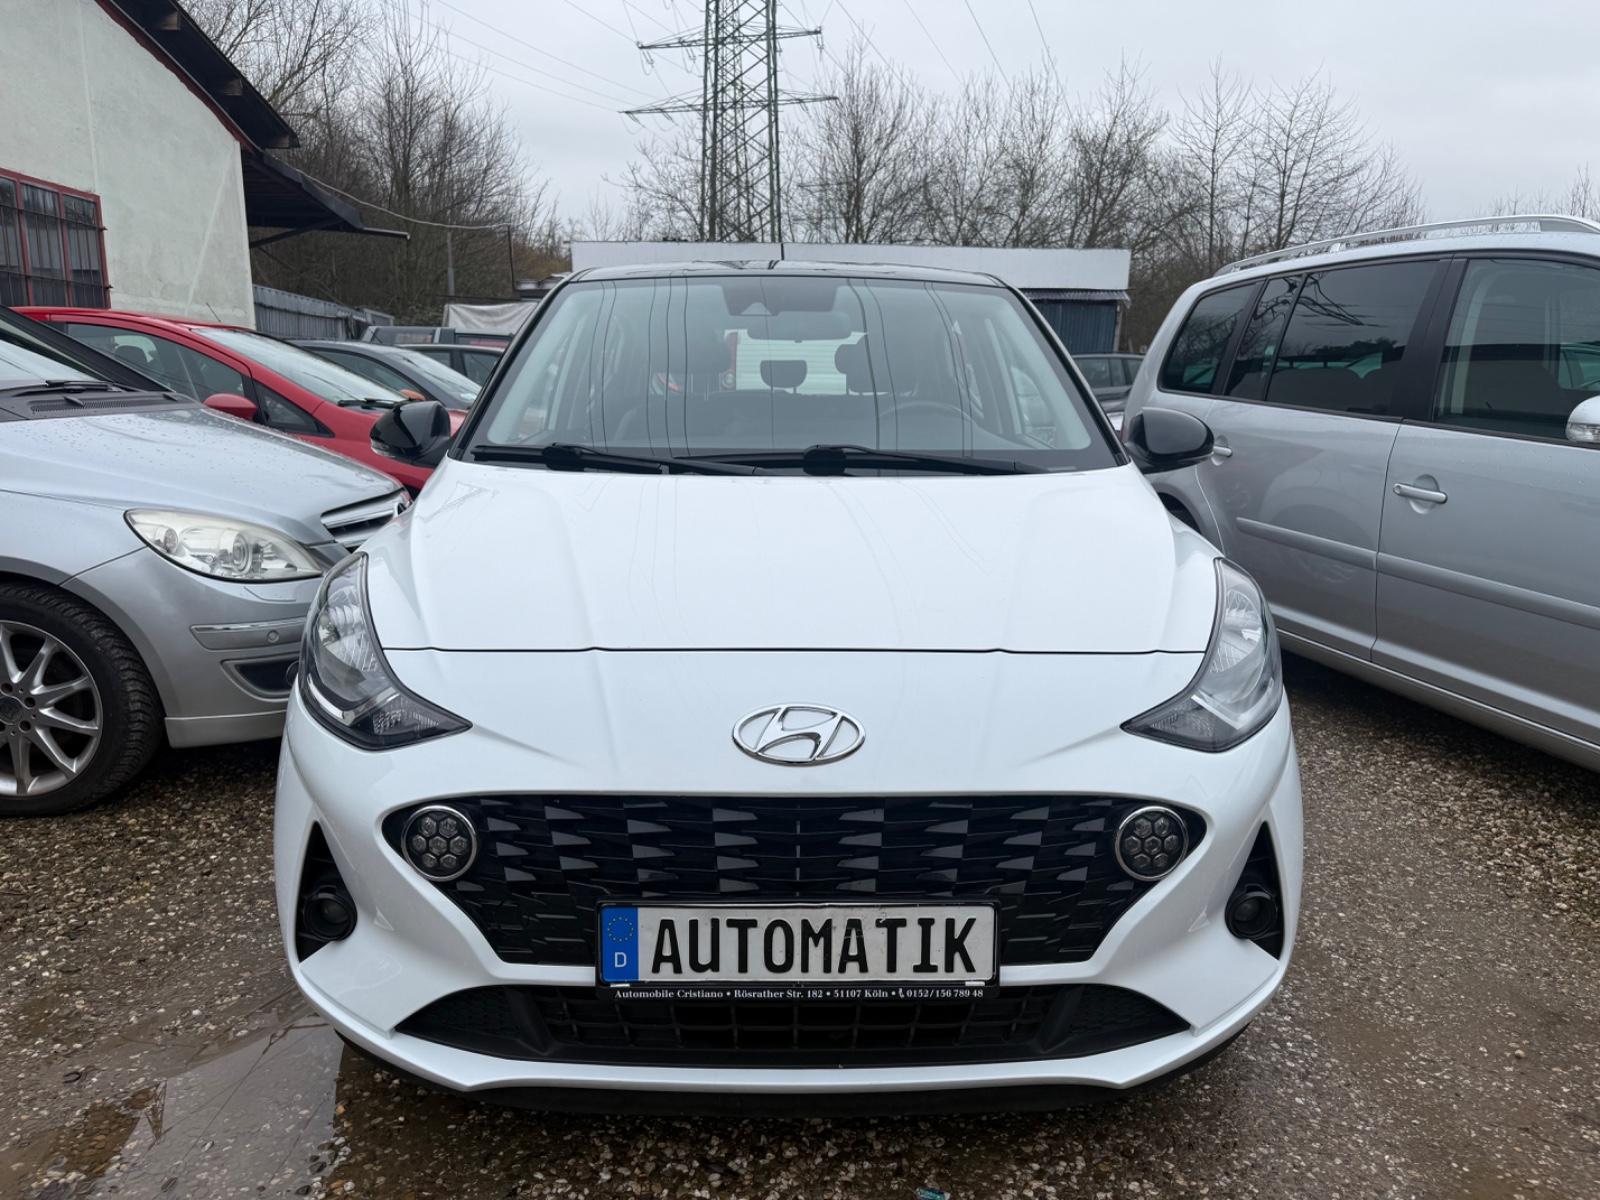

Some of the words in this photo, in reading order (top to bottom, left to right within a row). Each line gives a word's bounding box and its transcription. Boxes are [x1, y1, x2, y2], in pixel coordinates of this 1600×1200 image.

[651, 917, 977, 975] AUTOMATIK
[614, 951, 627, 968] D
[614, 989, 674, 999] Automobile
[677, 989, 723, 999] Cristiano
[734, 989, 784, 999] Rösrather
[787, 989, 804, 999] Str.
[807, 989, 823, 999] 182
[833, 989, 861, 999] 51107
[864, 989, 888, 999] Köln
